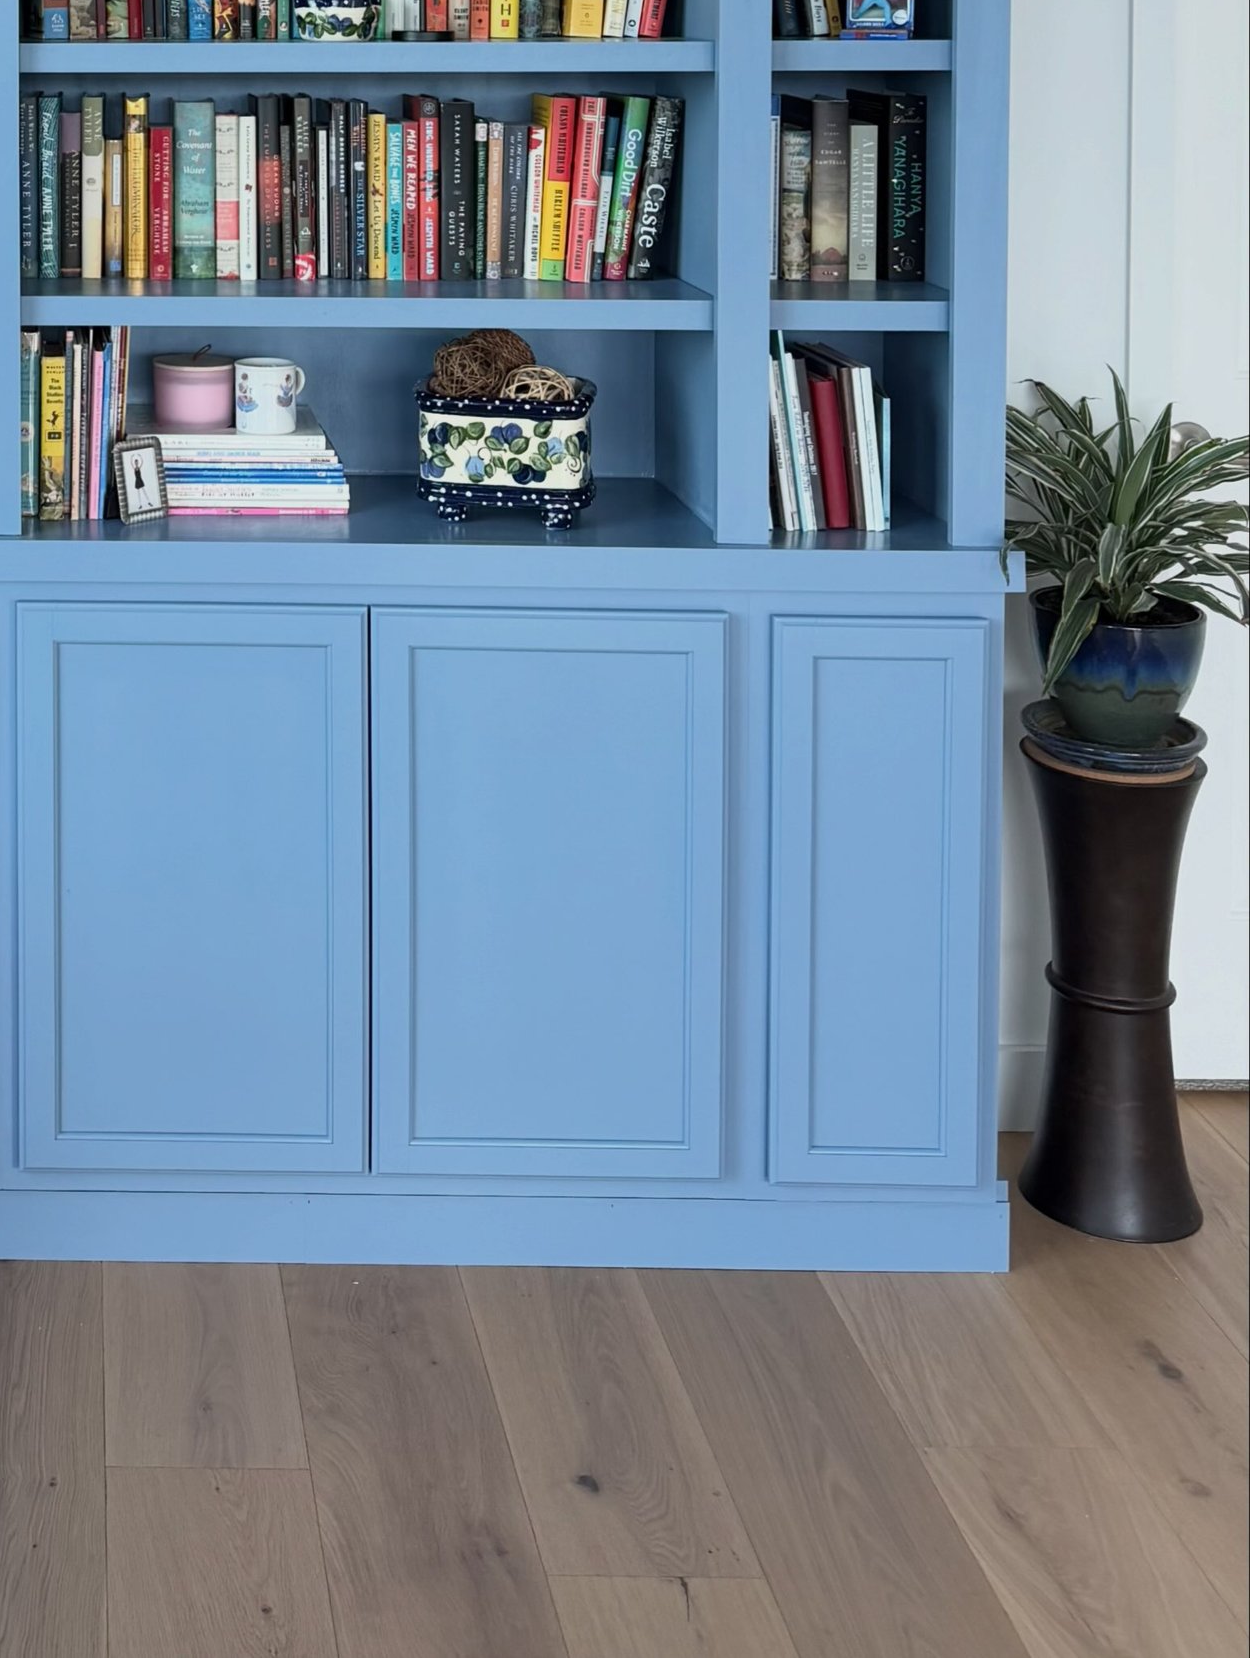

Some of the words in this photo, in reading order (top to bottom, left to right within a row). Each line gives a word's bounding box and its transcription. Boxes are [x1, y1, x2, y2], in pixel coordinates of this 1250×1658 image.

[162, 135, 170, 174] CUTTING
[406, 129, 417, 151] MEN
[624, 128, 643, 168] Good
[650, 116, 667, 169] Wilkerson
[662, 127, 676, 159] Isabel
[406, 154, 417, 169] WE
[862, 153, 874, 208] LITTLE
[42, 186, 54, 216] ANNE
[406, 172, 417, 210] REAPED
[620, 170, 636, 198] Dirt
[893, 137, 907, 239] YANAGIHARA
[910, 161, 922, 214] HANYA
[42, 217, 54, 252] TYLER
[153, 206, 161, 255] VERGHESE
[448, 210, 456, 246] GUESTS
[638, 182, 667, 249] Caste
[861, 213, 874, 247] LIFE
